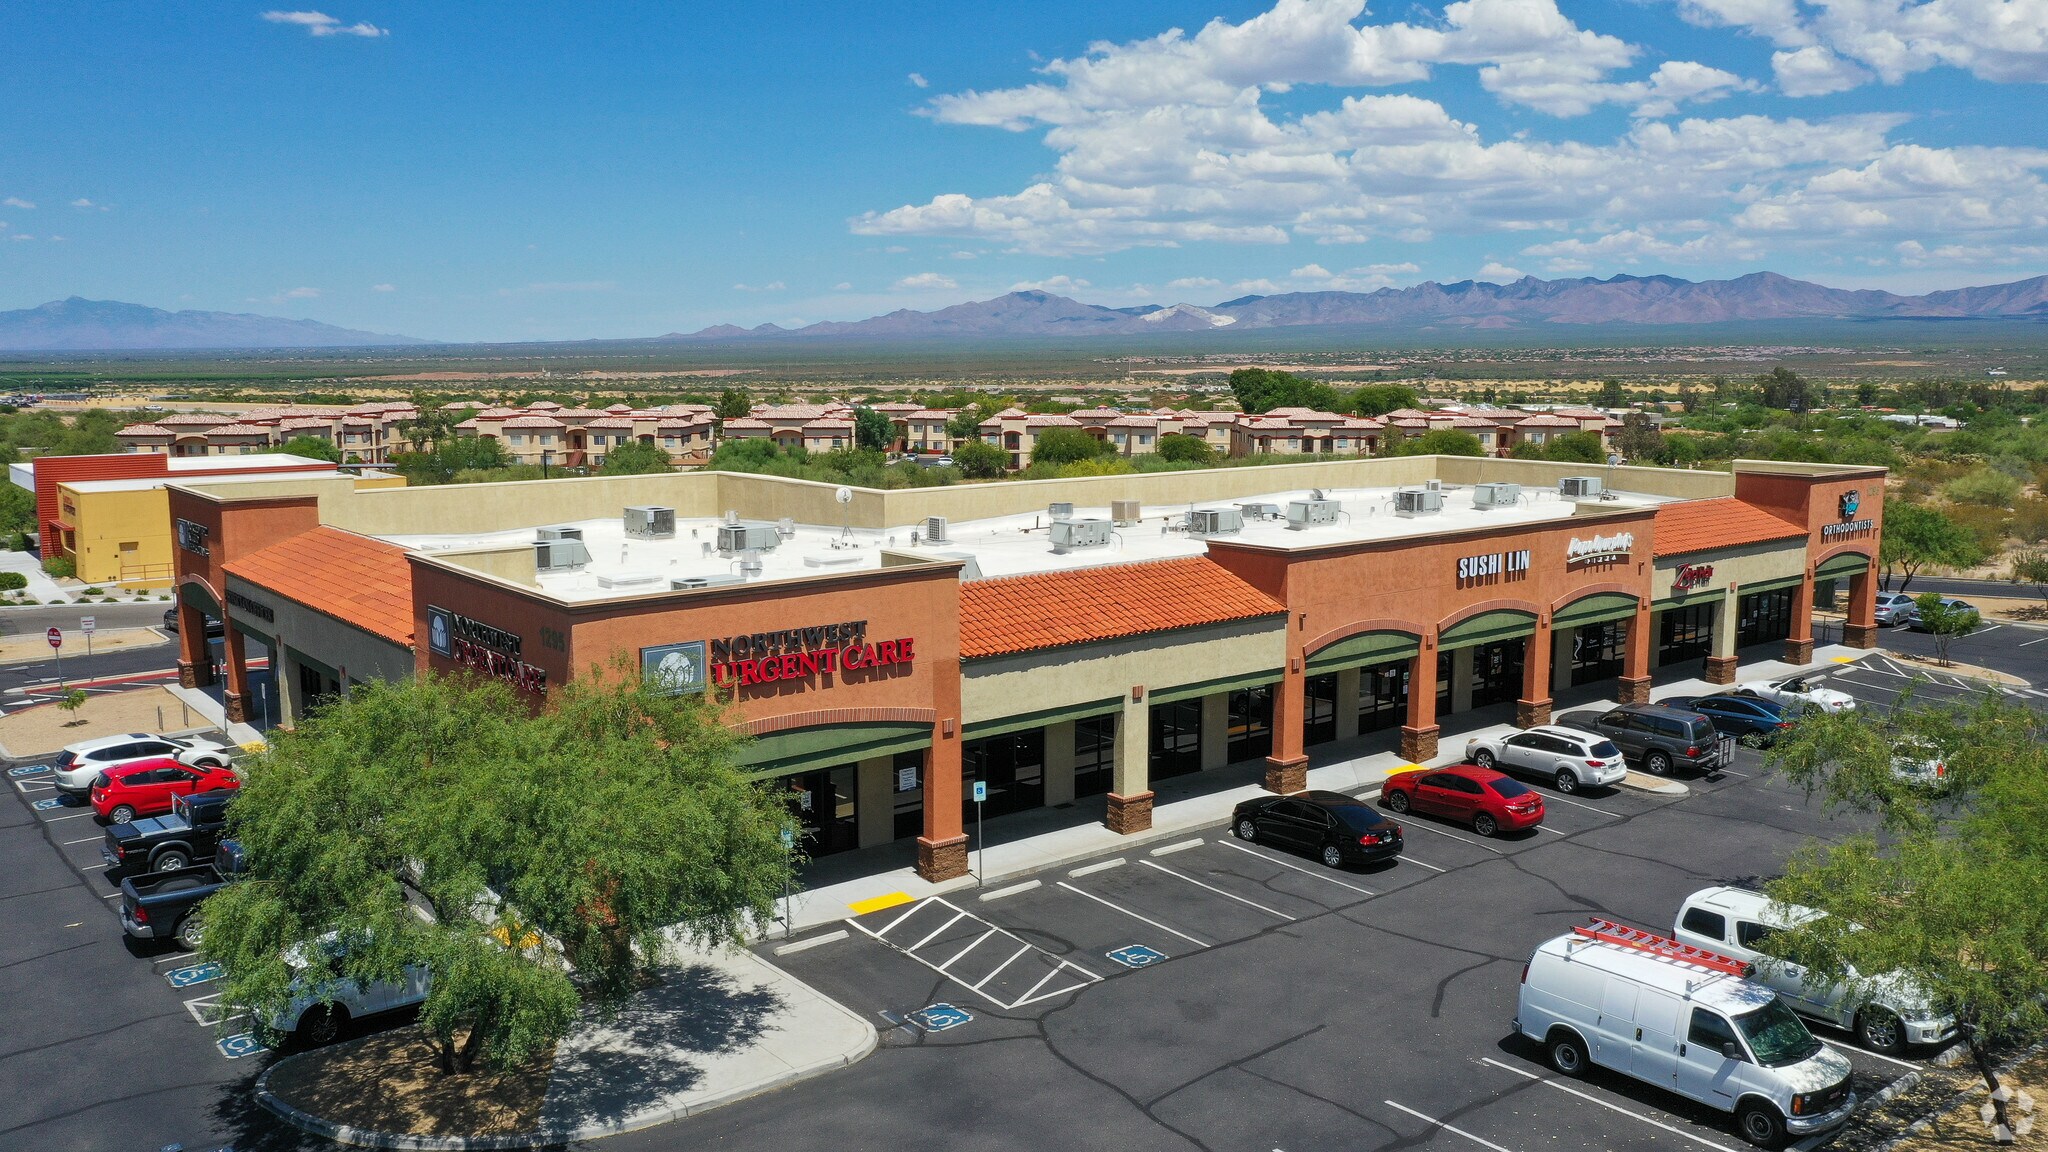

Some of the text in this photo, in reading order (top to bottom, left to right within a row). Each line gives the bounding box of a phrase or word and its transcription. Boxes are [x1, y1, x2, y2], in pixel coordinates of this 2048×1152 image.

[1824, 520, 1873, 535] ORTHODONTISTS
[1459, 550, 1530, 578] SUSHI LIN
[711, 620, 867, 657] NORTHWEST
[712, 637, 915, 688] URGENT CARE
